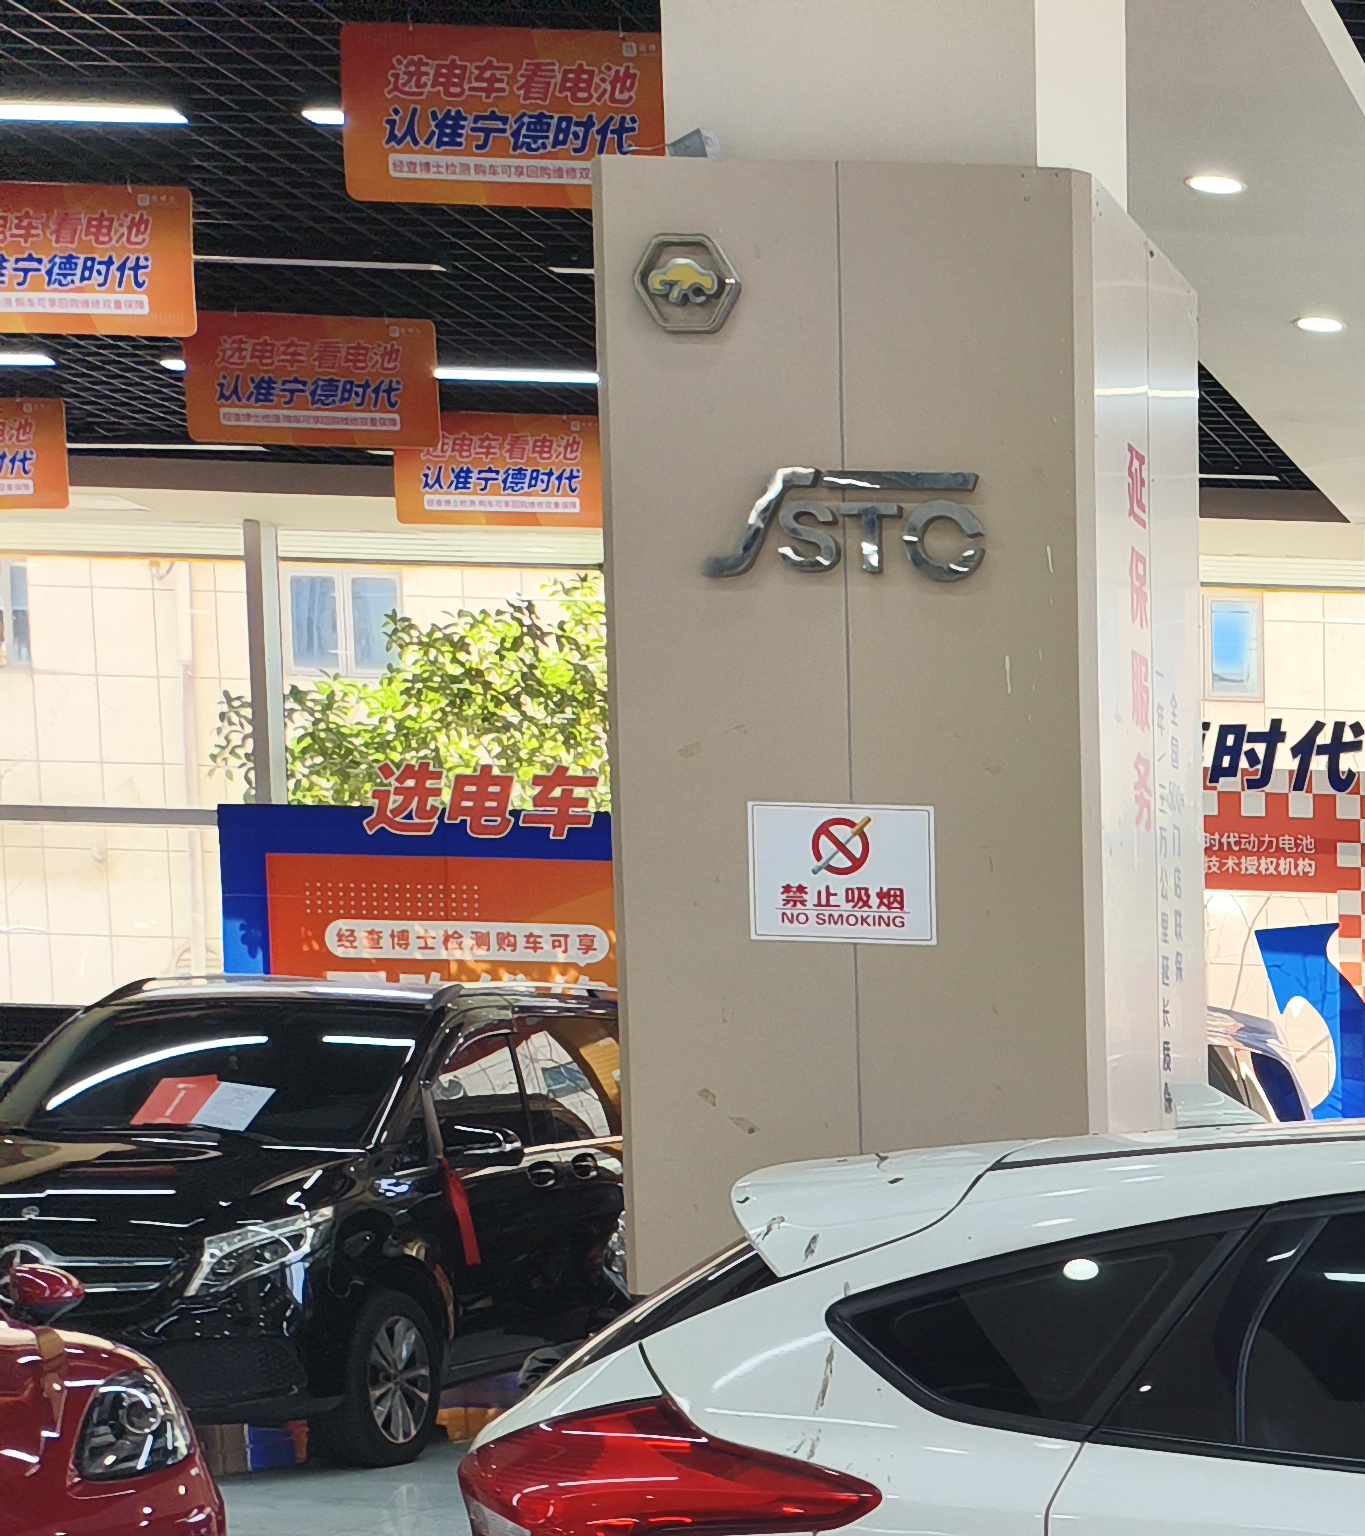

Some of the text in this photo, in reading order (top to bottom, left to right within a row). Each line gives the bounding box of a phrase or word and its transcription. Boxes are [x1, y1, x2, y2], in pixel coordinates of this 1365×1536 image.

[384, 55, 639, 107] 选电车 看电池
[382, 104, 640, 155] 认准宁德时代
[392, 159, 471, 175] 经查博士检测
[49, 210, 152, 247] 看电池
[215, 335, 402, 374] 选电车 看电池
[215, 372, 403, 409] 认准宁德时代
[0, 416, 35, 445] 池
[0, 448, 36, 477] 代
[504, 433, 583, 463] 看电池
[421, 465, 583, 494] 认准宁德时代
[1127, 442, 1152, 832] 延保服务
[1202, 718, 1364, 794] 时代
[364, 760, 599, 840] 选电车
[1204, 832, 1316, 853] 时代动力电池
[1204, 855, 1316, 876] 技术授权机构
[780, 883, 905, 911] 禁止吸烟
[781, 911, 905, 928] NO SMOKING
[335, 927, 598, 954] 经查博士检测购车可享
